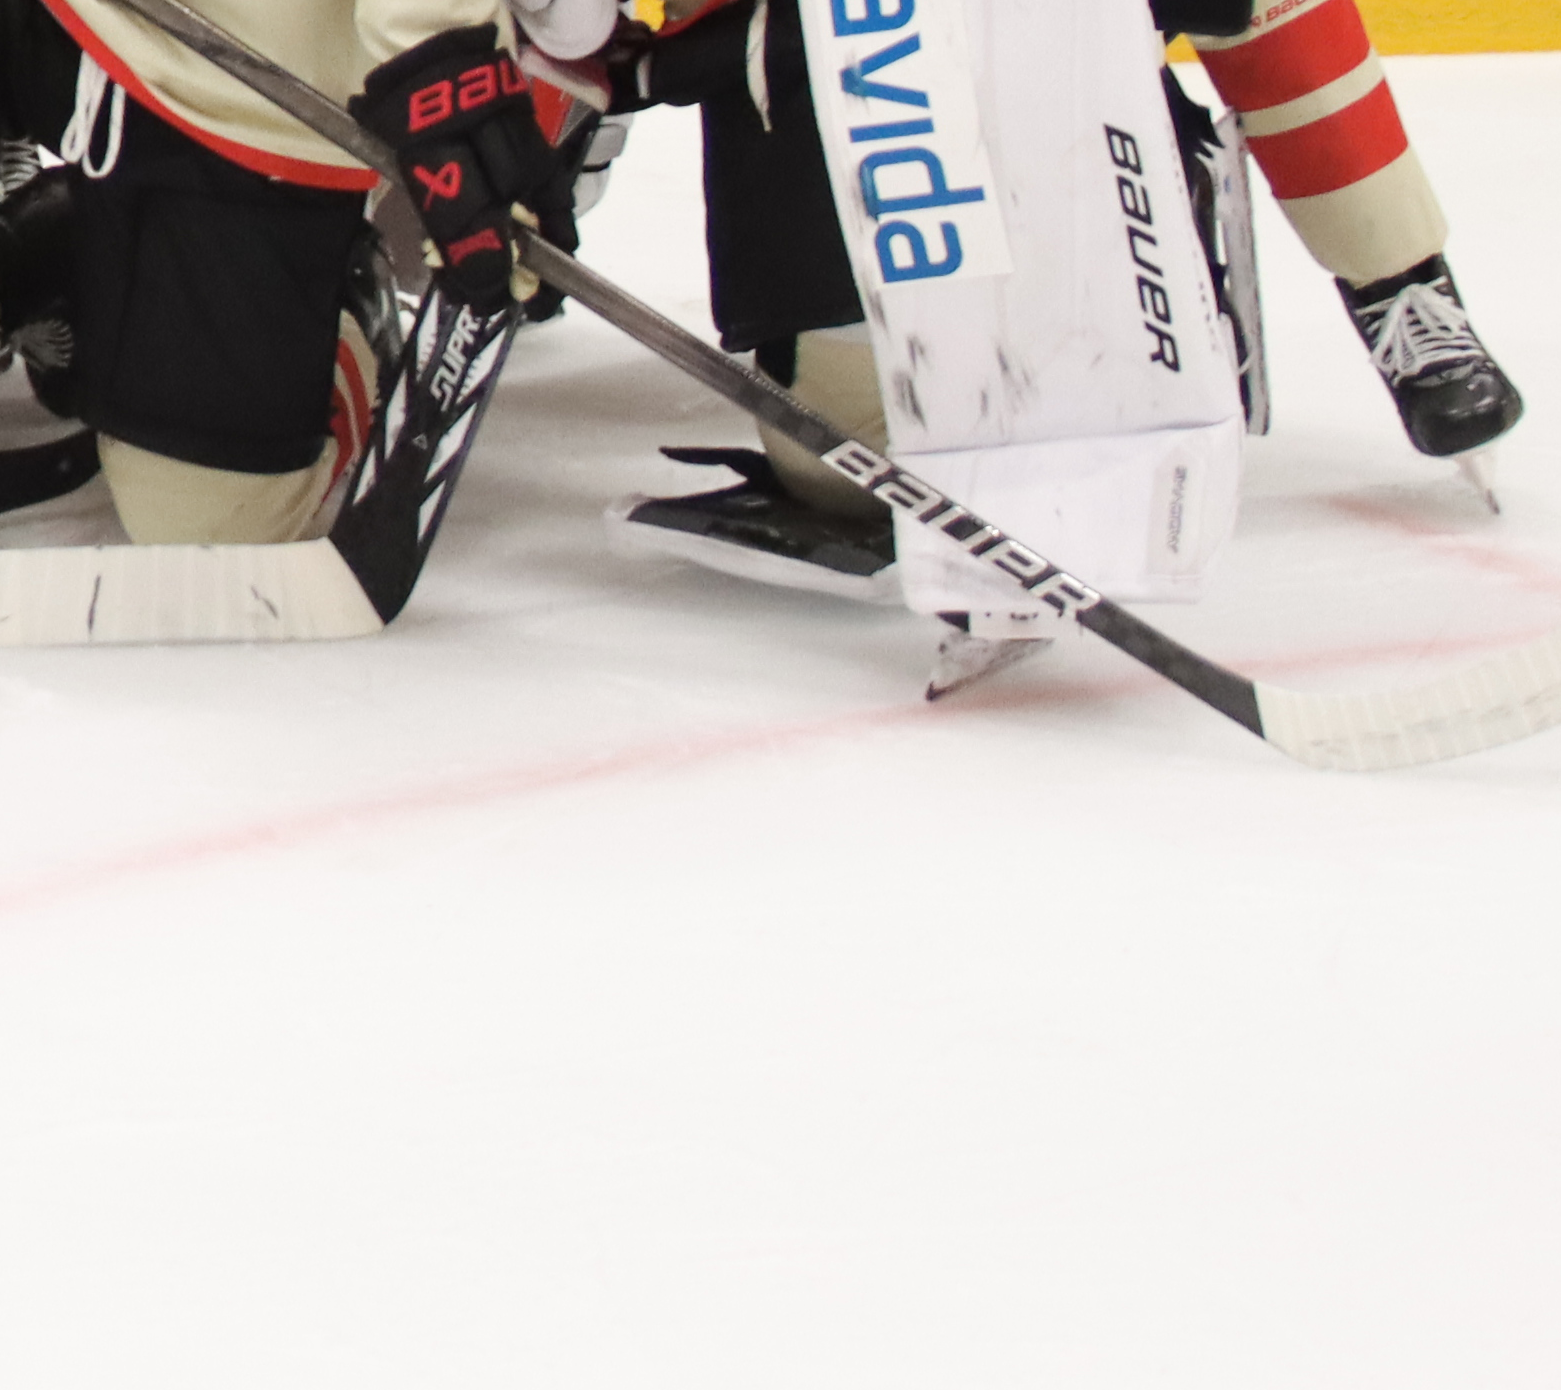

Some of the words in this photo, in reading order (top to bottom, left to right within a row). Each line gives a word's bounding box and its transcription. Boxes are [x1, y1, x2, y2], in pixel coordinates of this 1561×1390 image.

[407, 58, 530, 133] BAU
[1101, 121, 1184, 376] BAUER
[820, 436, 1103, 620] BAUER
